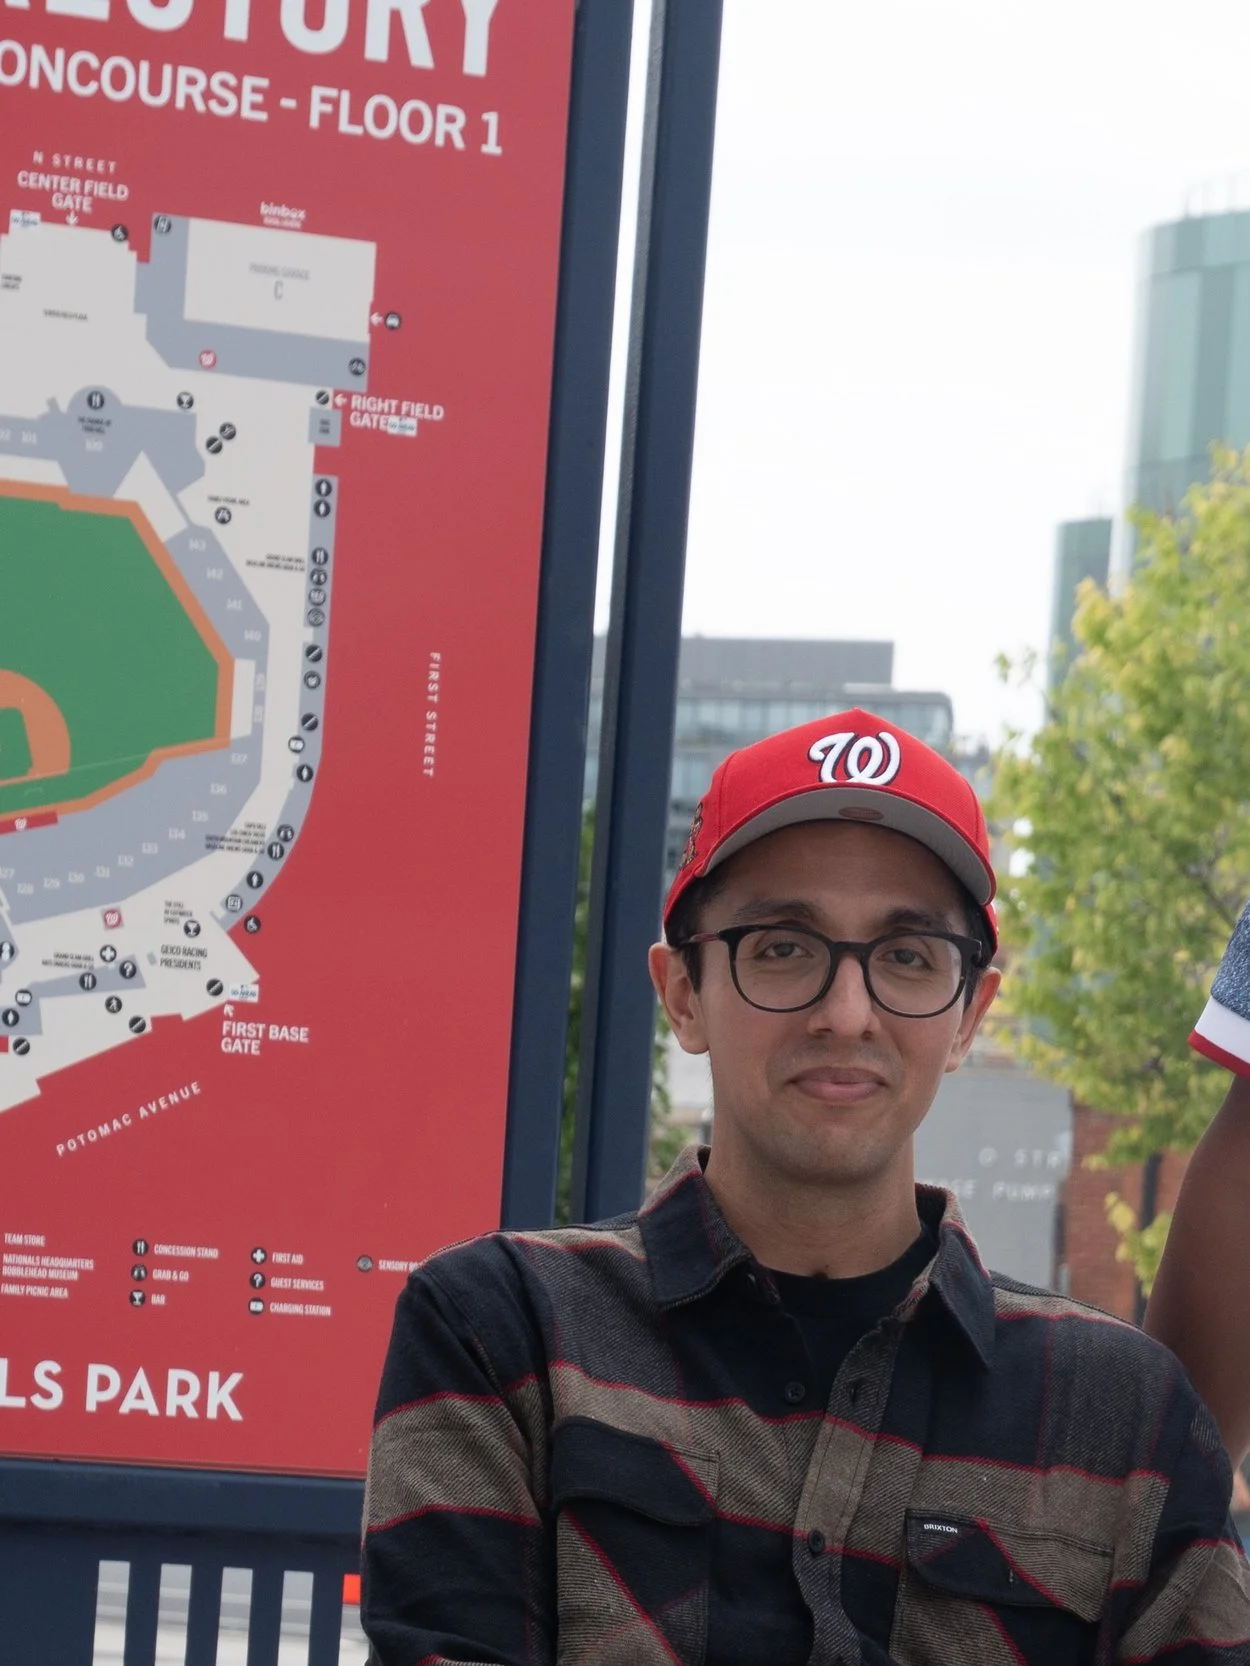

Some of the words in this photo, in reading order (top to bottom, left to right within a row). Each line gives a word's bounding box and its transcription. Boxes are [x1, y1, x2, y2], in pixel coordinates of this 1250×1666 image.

[309, 84, 466, 151] FLOOR
[481, 111, 502, 156] 1
[33, 150, 44, 165] N
[52, 152, 117, 174] STREET
[17, 170, 81, 193] CENTER
[84, 179, 129, 201] FIELD
[51, 192, 93, 214] GATE
[351, 394, 398, 414] RIGHT
[401, 400, 444, 421] FIELD
[350, 411, 390, 432] GATE
[427, 651, 441, 704] FIRST
[423, 710, 437, 778] STREET
[808, 731, 902, 786] W
[160, 944, 181, 956] GEICO
[182, 946, 208, 958] RACING
[160, 957, 202, 971] PRESIDENTS
[222, 1020, 266, 1038] FIRST
[268, 1024, 309, 1043] BASE
[221, 1037, 260, 1055] GATE
[56, 1113, 132, 1158] POTOMAC
[138, 1081, 201, 1119] AVENUE
[4, 1232, 23, 1245] TEAM
[24, 1234, 45, 1247] STORE
[154, 1243, 196, 1257] CONCESSION
[196, 1246, 219, 1259] STAND
[272, 1252, 291, 1264] FIRST
[291, 1253, 304, 1265] AID
[3, 1253, 41, 1266] NATIONALS
[41, 1255, 95, 1271] HEADQUARTERS
[378, 1259, 408, 1272] SENSORY
[48, 1268, 79, 1281] MUSEUM
[152, 1268, 171, 1281] GRAB
[1, 1283, 25, 1296] FAMILY
[25, 1284, 50, 1298] PICNIC
[50, 1286, 69, 1299] AREA
[270, 1277, 291, 1289] GUEST
[292, 1278, 325, 1291] SERVICES
[151, 1293, 166, 1305] BAR
[269, 1302, 304, 1315] CHARGING
[304, 1304, 331, 1317] STATION
[85, 1362, 244, 1421] PARK
[923, 1523, 958, 1534] BRIXTON
